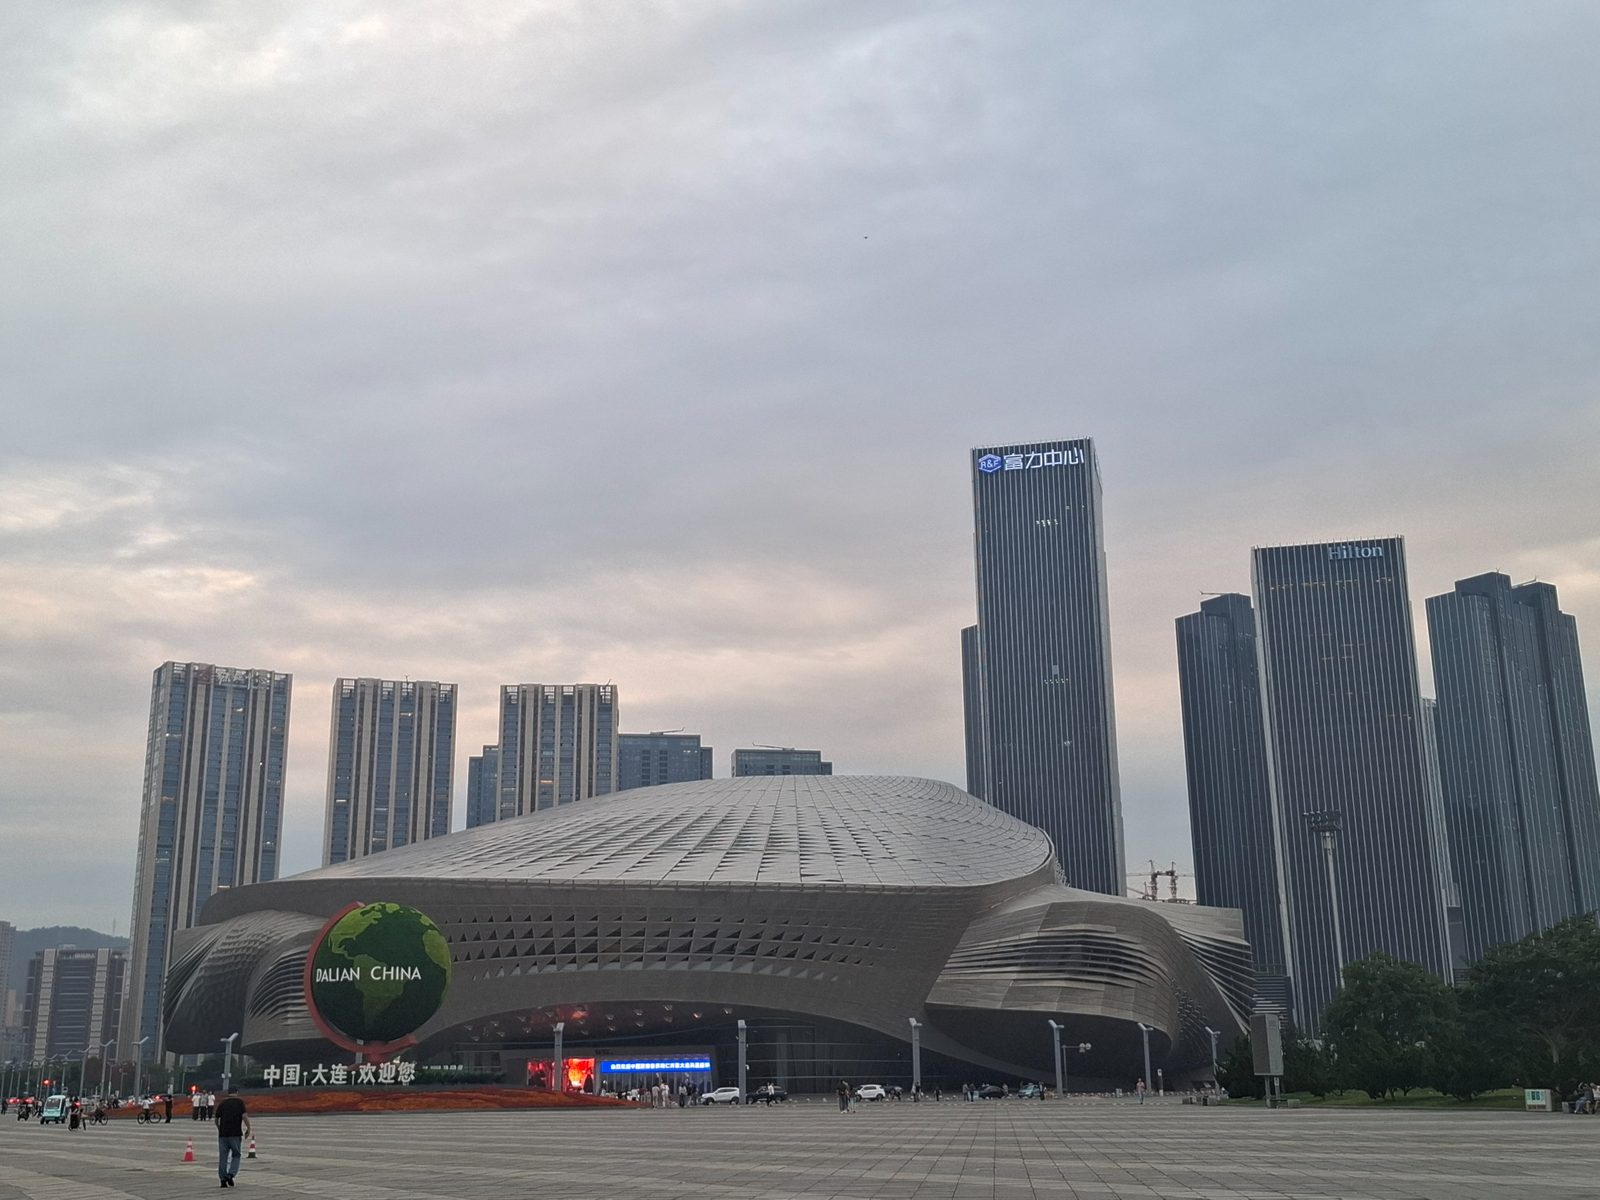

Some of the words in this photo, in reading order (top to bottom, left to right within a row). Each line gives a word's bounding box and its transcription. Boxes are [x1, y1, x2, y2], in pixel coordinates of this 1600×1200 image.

[1004, 447, 1084, 470] 富力中心
[1328, 544, 1383, 560] Hilton
[316, 966, 360, 983] DALIAN
[370, 966, 422, 981] CHINA
